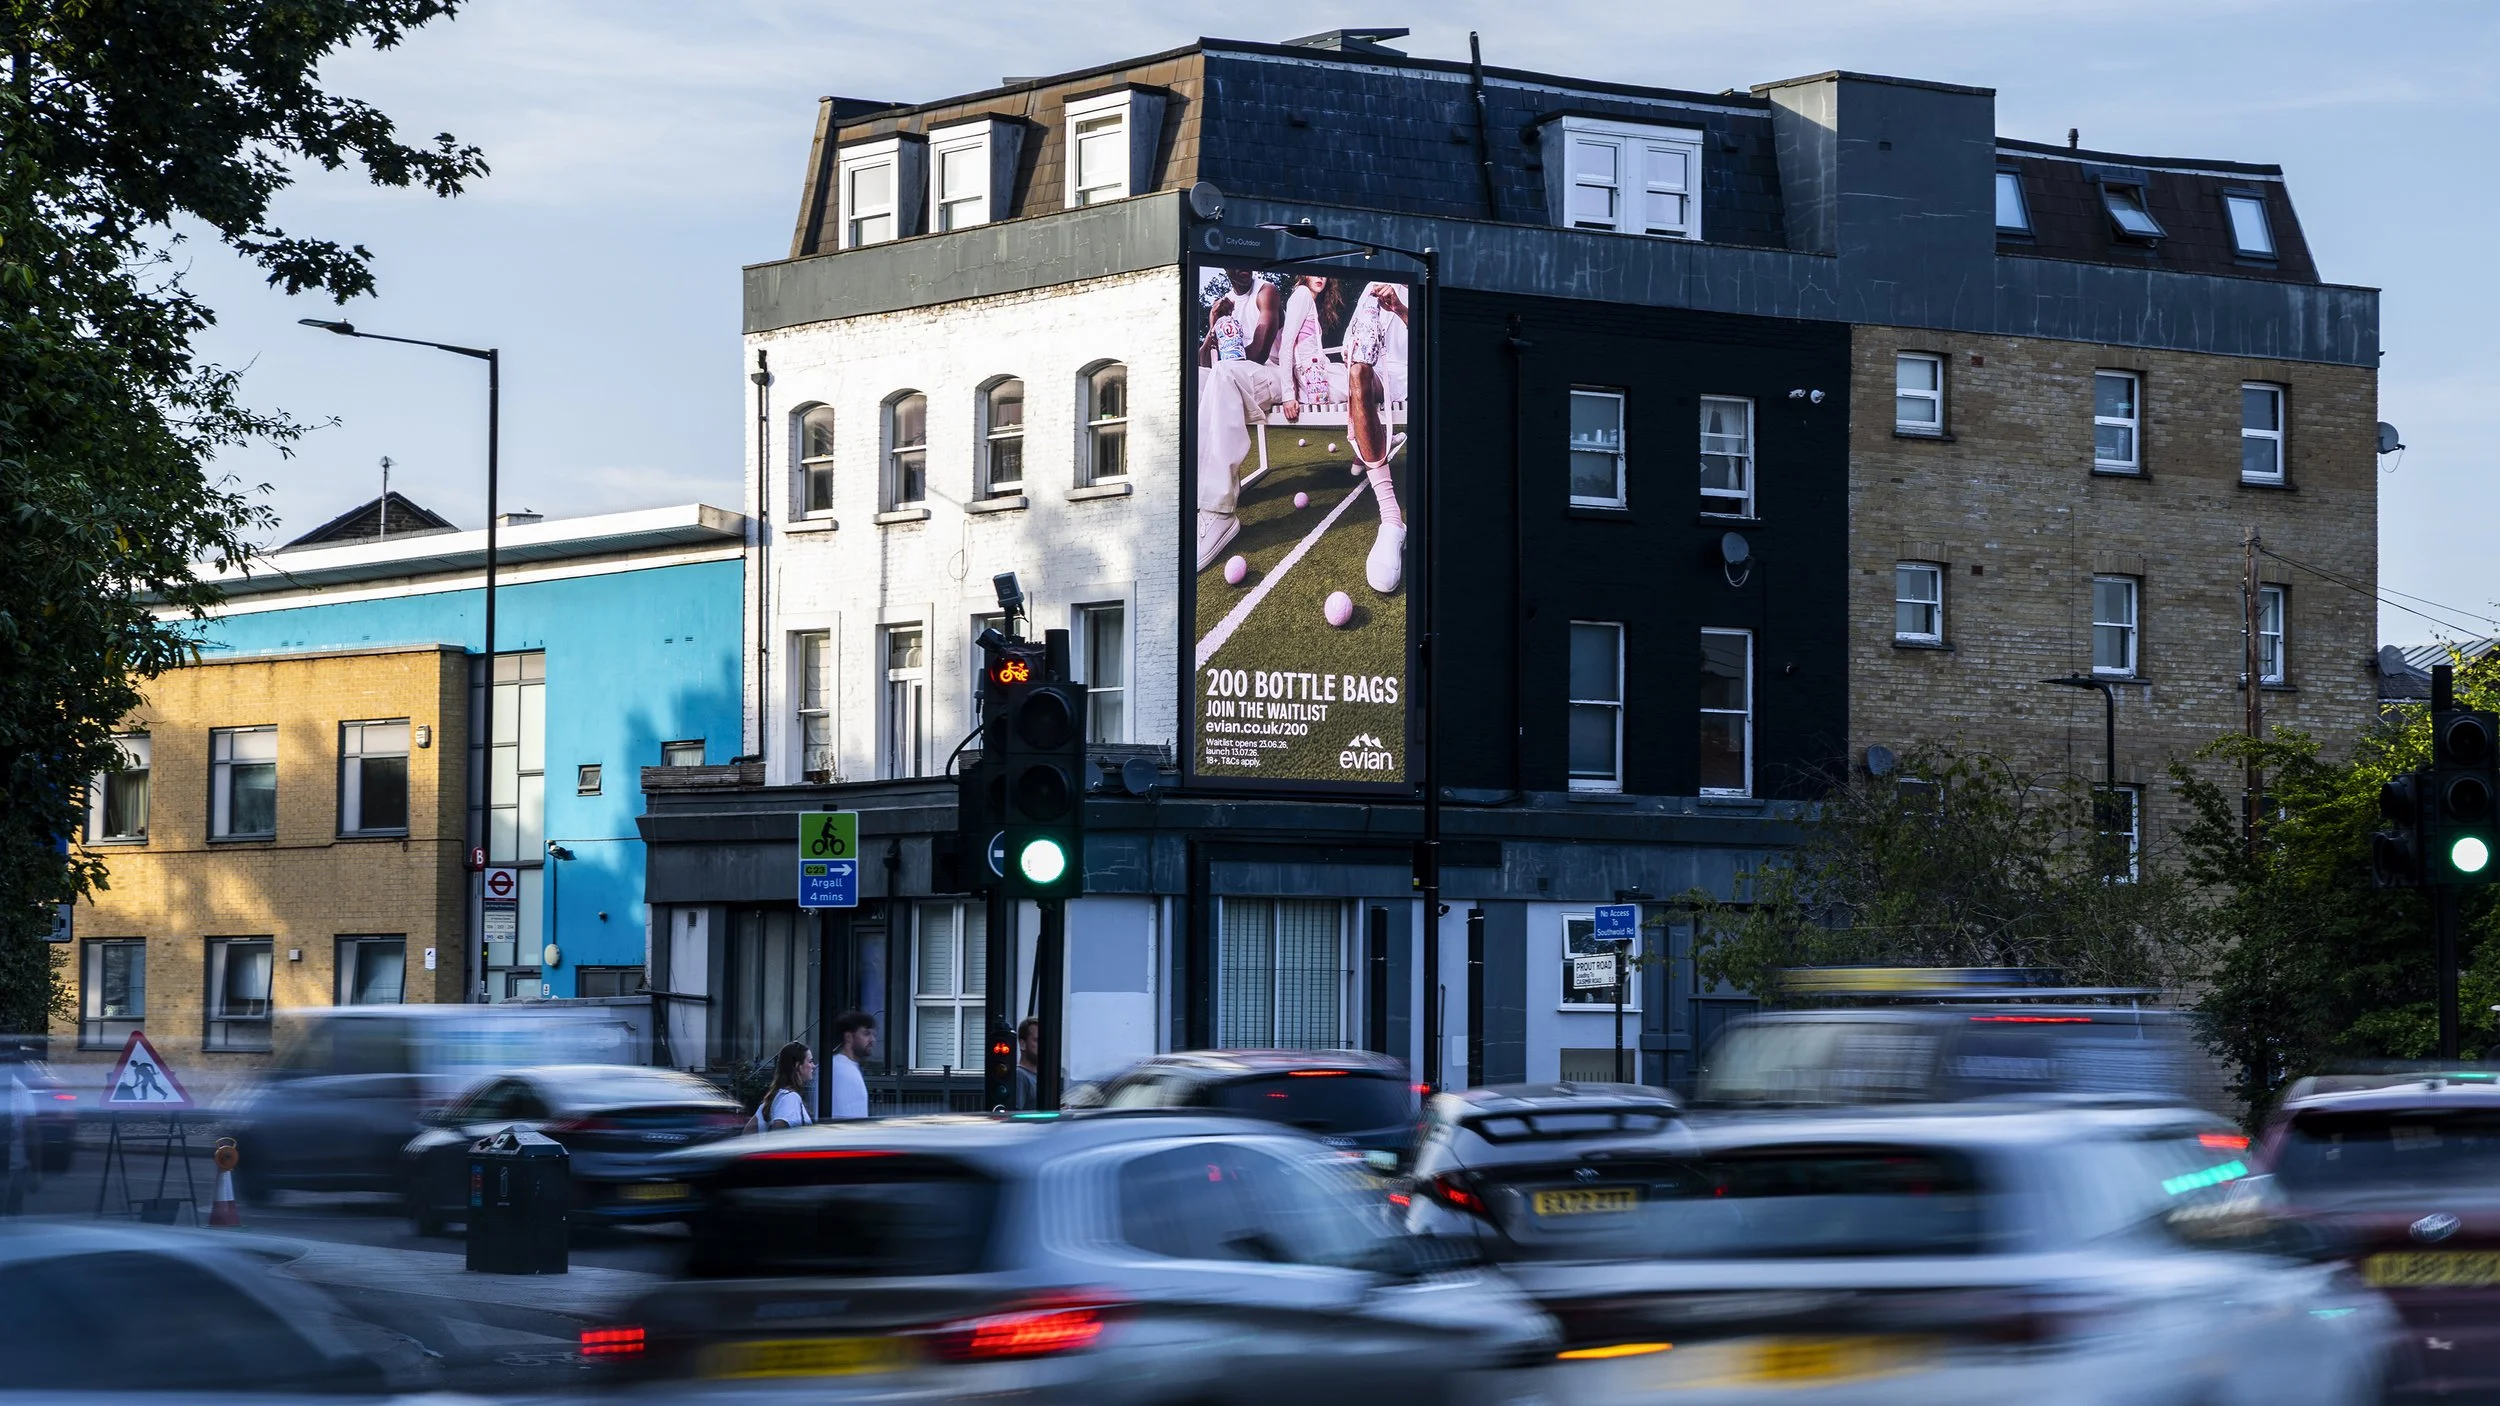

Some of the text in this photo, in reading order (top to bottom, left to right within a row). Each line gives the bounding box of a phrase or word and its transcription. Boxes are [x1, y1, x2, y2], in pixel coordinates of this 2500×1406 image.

[1206, 668, 1399, 704] 200 BOTTLE BAGS
[1205, 700, 1328, 721] JOIN THE WAITLIST
[1205, 719, 1308, 736] evian.co.uk/200
[1206, 738, 1234, 747] Waitlist
[1235, 740, 1258, 748] opens
[1206, 746, 1230, 755] launch
[1221, 757, 1240, 766] T&Cs
[476, 850, 484, 865] B
[805, 866, 825, 874] C23
[811, 878, 843, 889] Argall
[810, 891, 844, 901] 4 mins
[1600, 909, 1630, 918] No Access
[1611, 918, 1619, 926] To
[1597, 927, 1634, 937] Southwold Rd
[1576, 960, 1613, 972] PROUT ROAD
